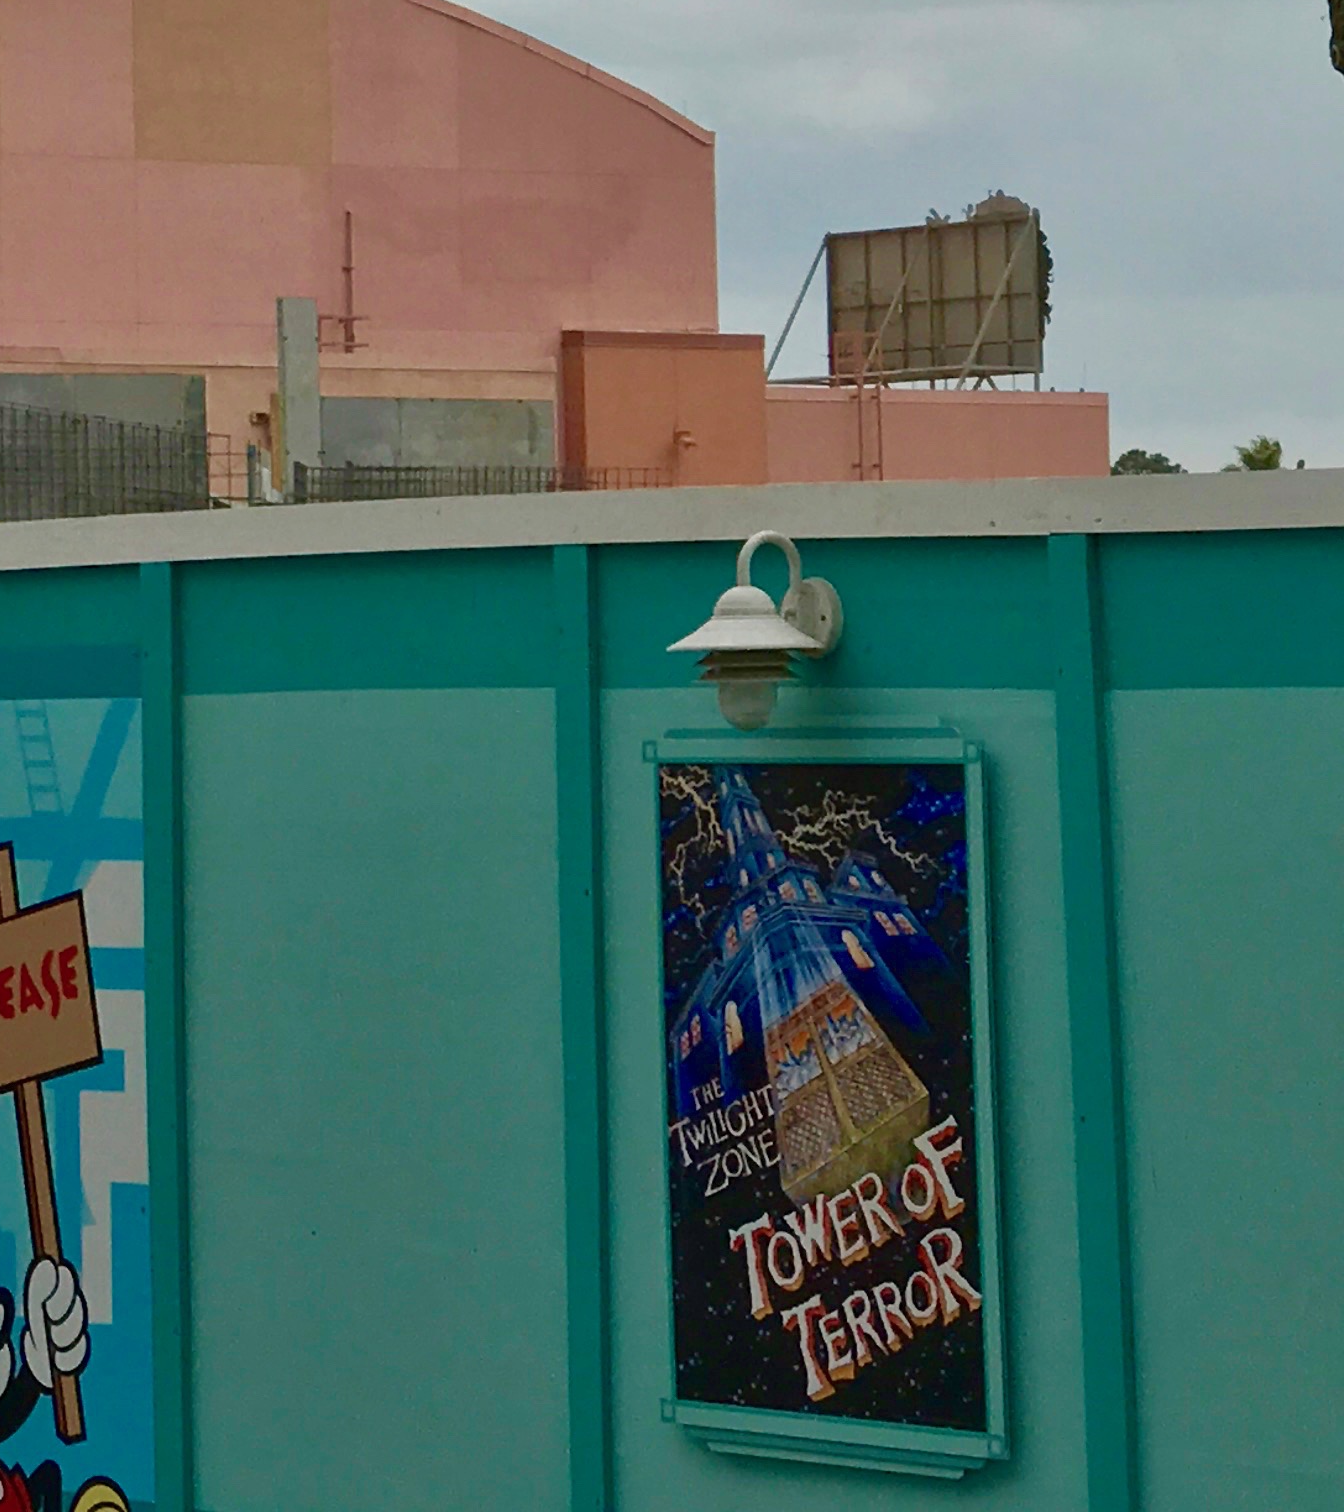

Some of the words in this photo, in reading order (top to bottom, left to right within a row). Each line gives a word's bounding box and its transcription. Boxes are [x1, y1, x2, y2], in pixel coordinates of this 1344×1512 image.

[669, 1084, 774, 1167] TWILIGHT
[690, 1077, 726, 1110] THE
[696, 1128, 781, 1197] ZONE
[728, 1172, 906, 1320] TOWER
[901, 1114, 965, 1221] OF
[780, 1227, 982, 1402] TERROR
